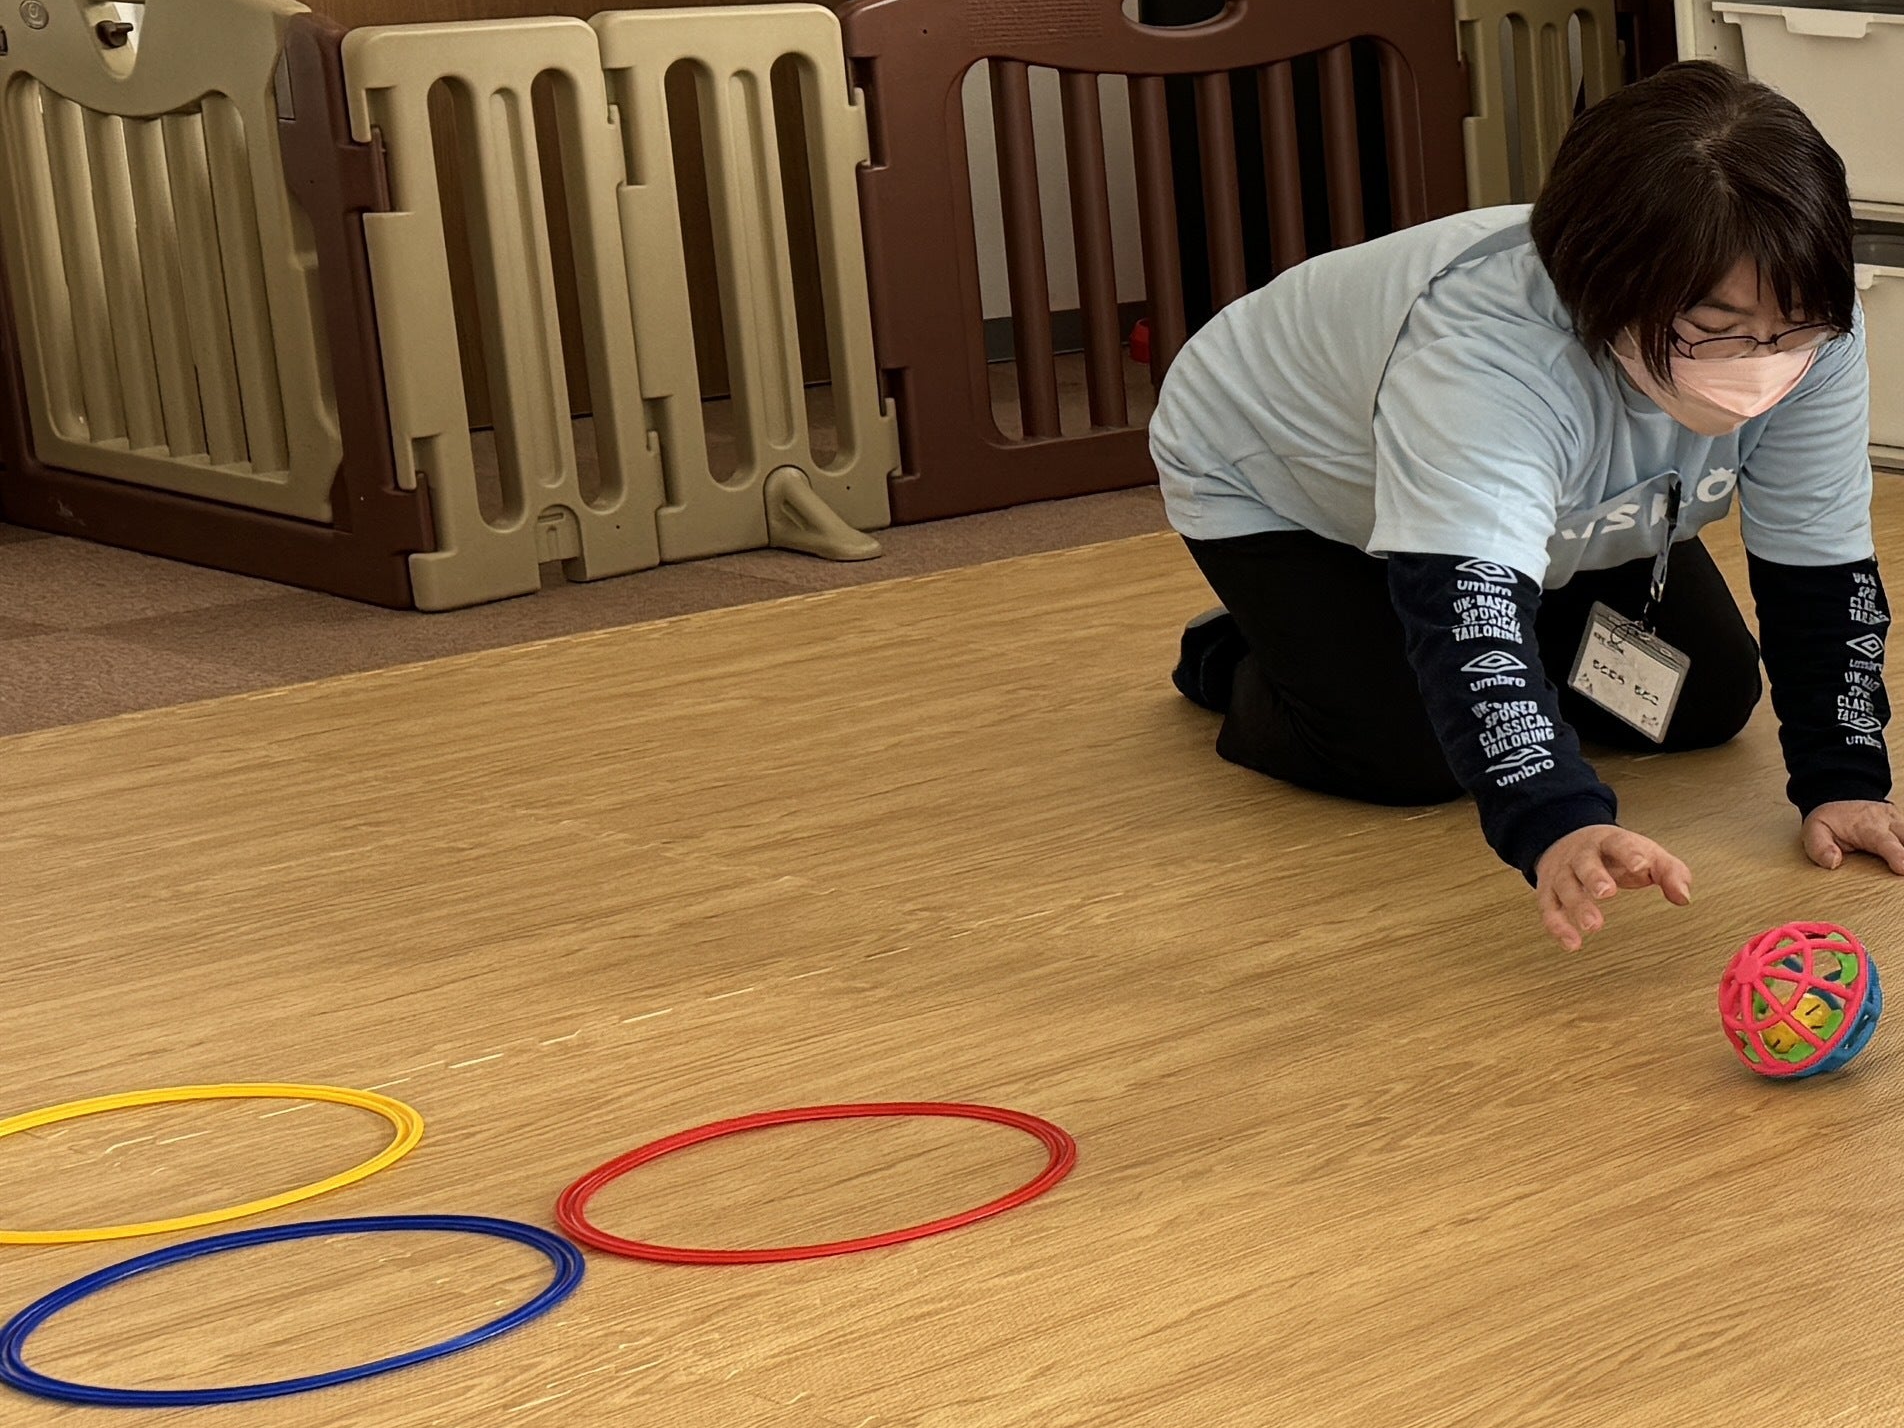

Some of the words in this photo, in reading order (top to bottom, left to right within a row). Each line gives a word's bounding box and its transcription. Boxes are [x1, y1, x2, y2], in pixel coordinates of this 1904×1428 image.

[1469, 674, 1527, 692] umbro
[1479, 714, 1554, 748] CLASSICAL
[1483, 727, 1555, 759] TAILORING
[1496, 758, 1555, 787] umbro
